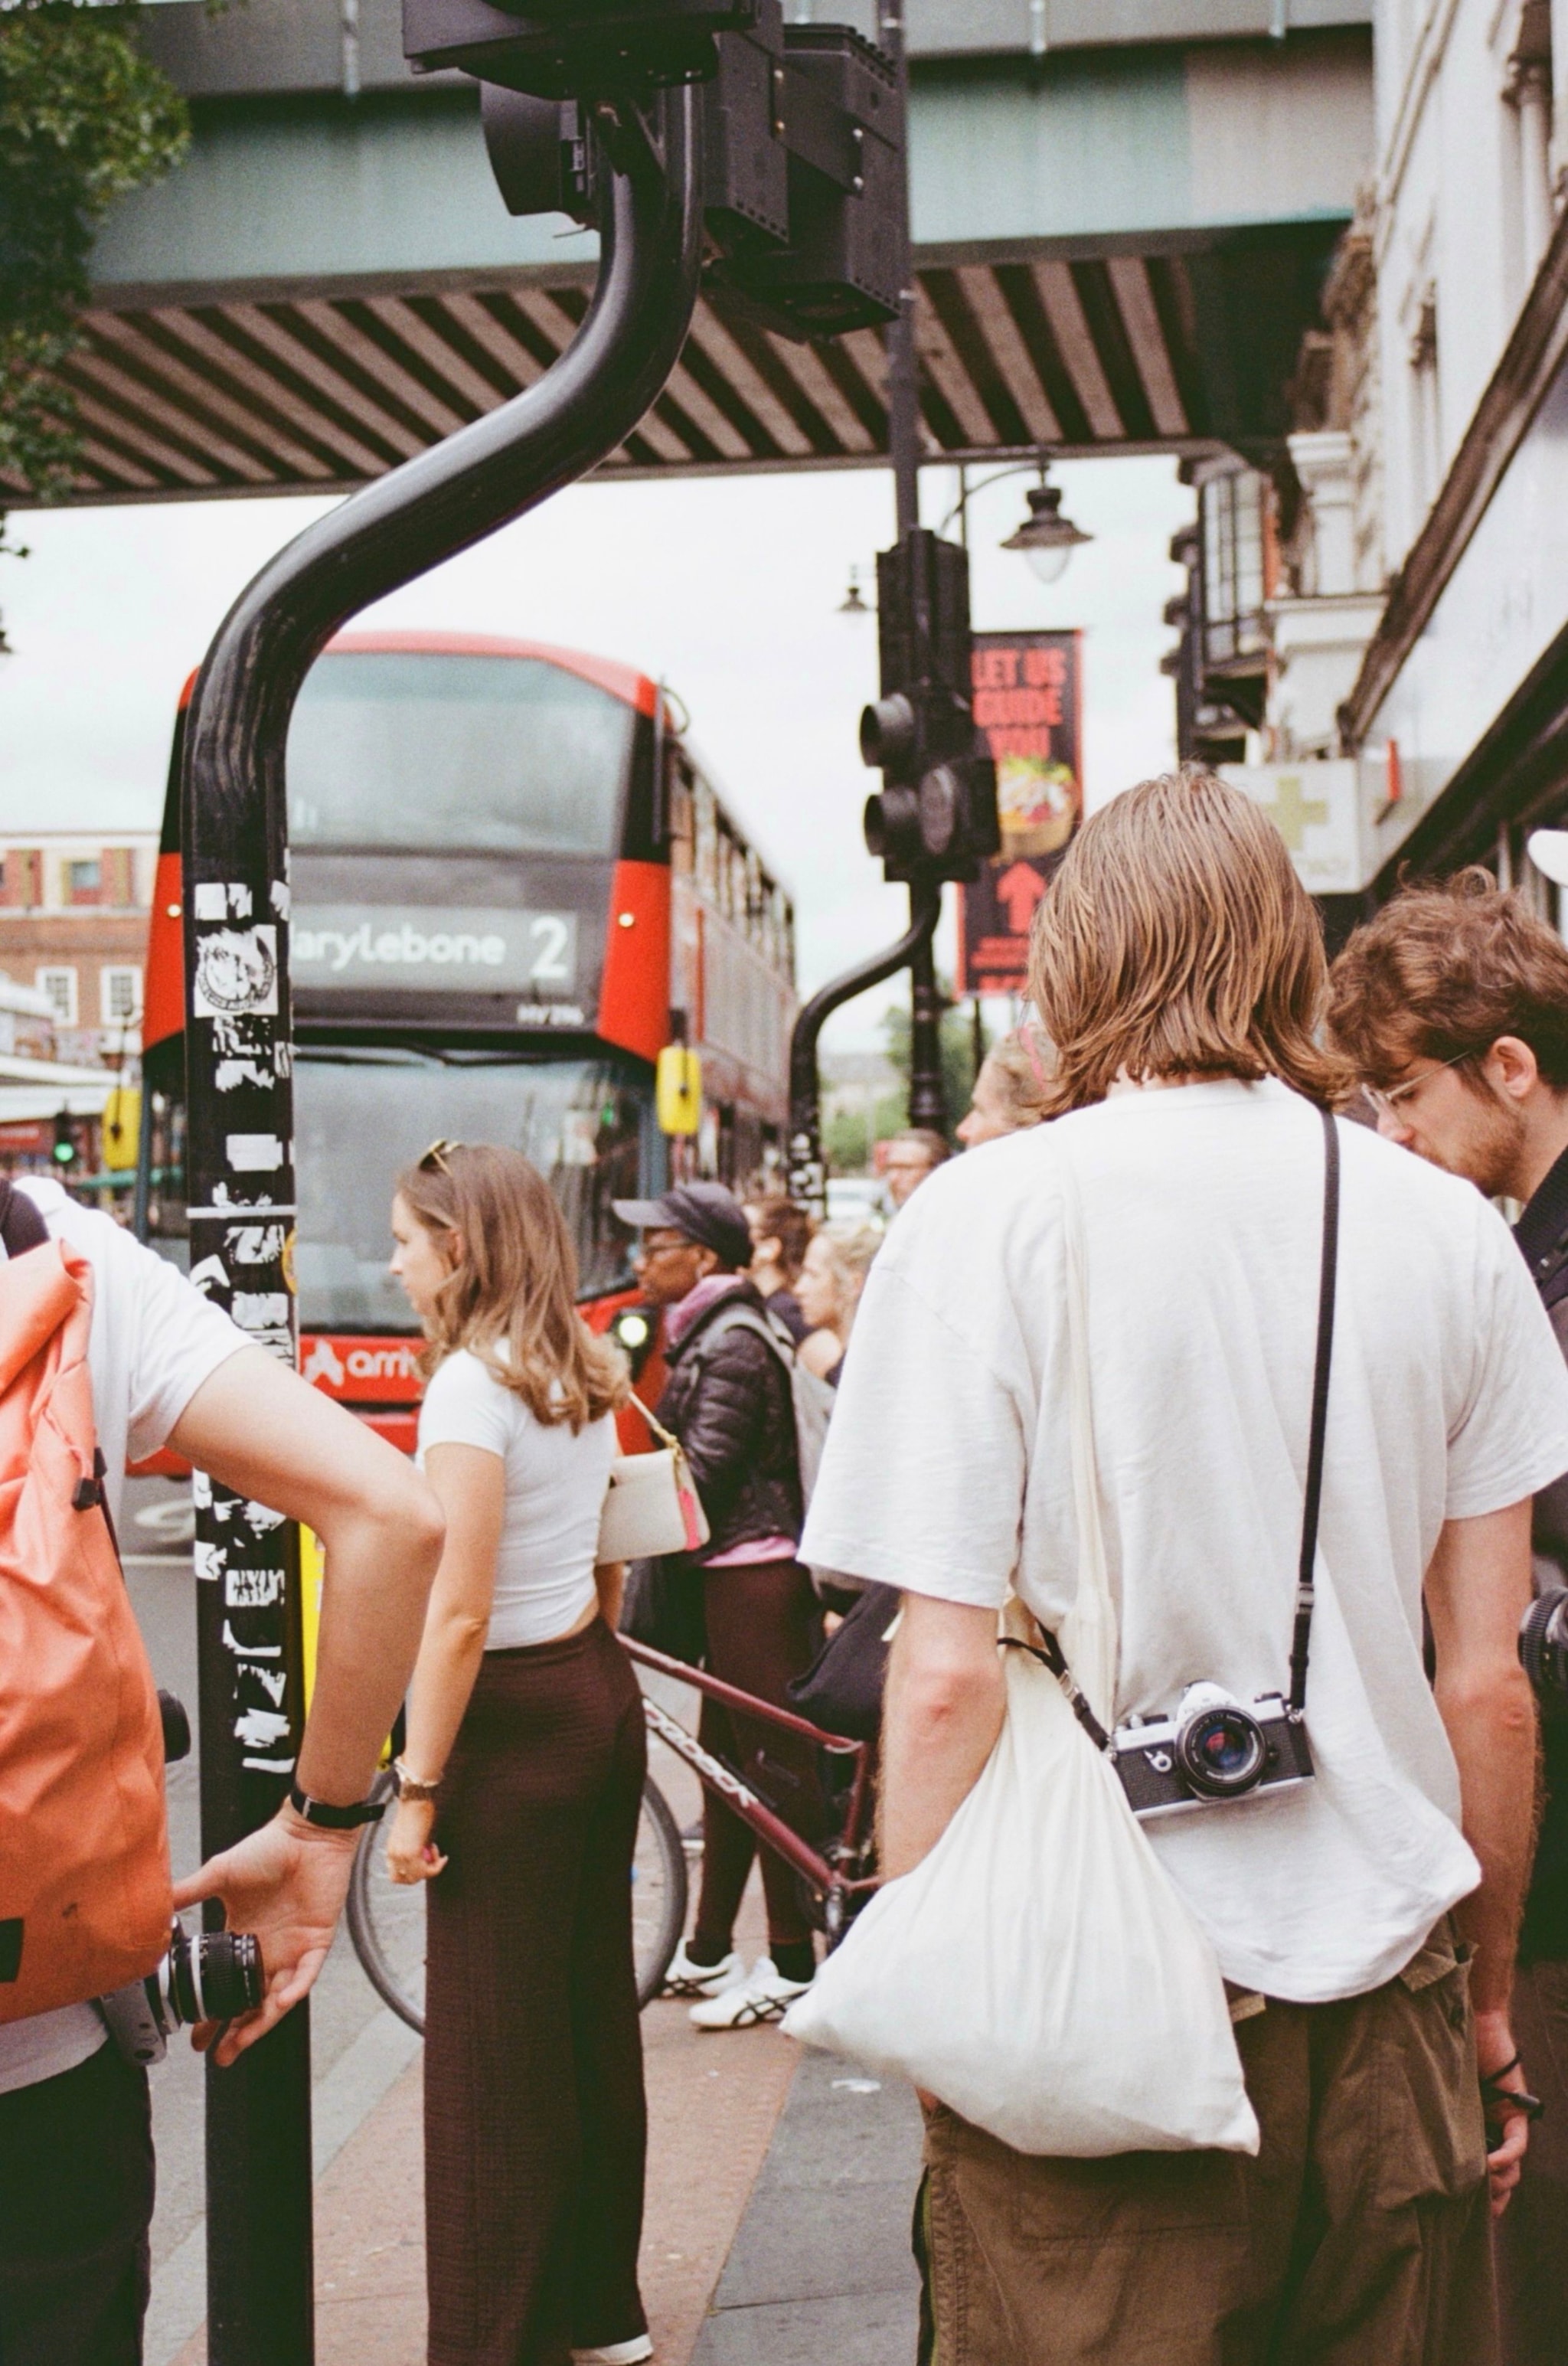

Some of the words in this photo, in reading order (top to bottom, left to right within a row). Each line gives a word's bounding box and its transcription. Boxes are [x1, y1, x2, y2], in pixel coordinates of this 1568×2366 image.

[971, 649, 1019, 688] LET
[1024, 647, 1067, 686] US
[289, 923, 507, 972] arylebone
[529, 915, 569, 979] 2
[346, 1345, 417, 1378] arri
